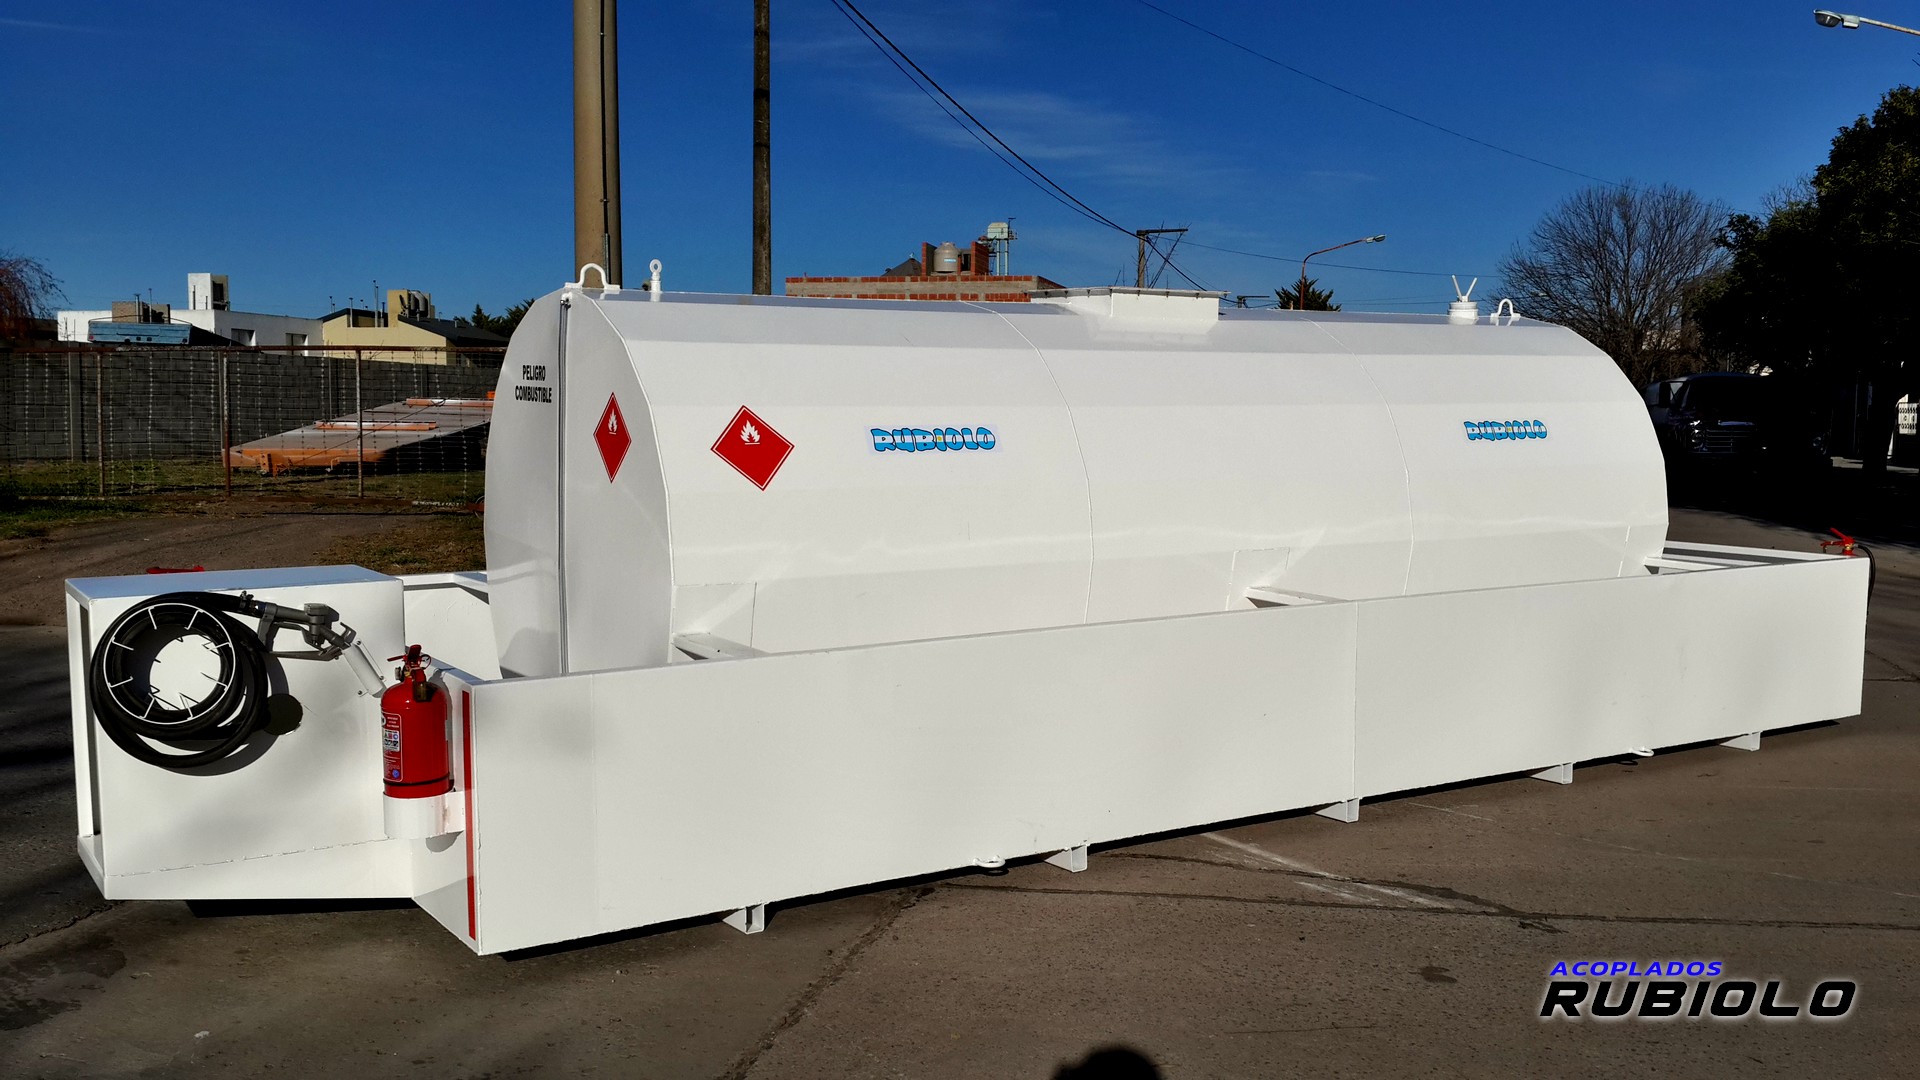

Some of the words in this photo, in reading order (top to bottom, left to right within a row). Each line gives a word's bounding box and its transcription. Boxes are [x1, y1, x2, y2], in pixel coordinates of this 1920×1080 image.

[522, 364, 546, 381] PELIGRO
[515, 385, 552, 403] COMBUSTIBLE
[870, 427, 996, 452] RUBIOLO
[1463, 420, 1548, 441] RUBIOLO
